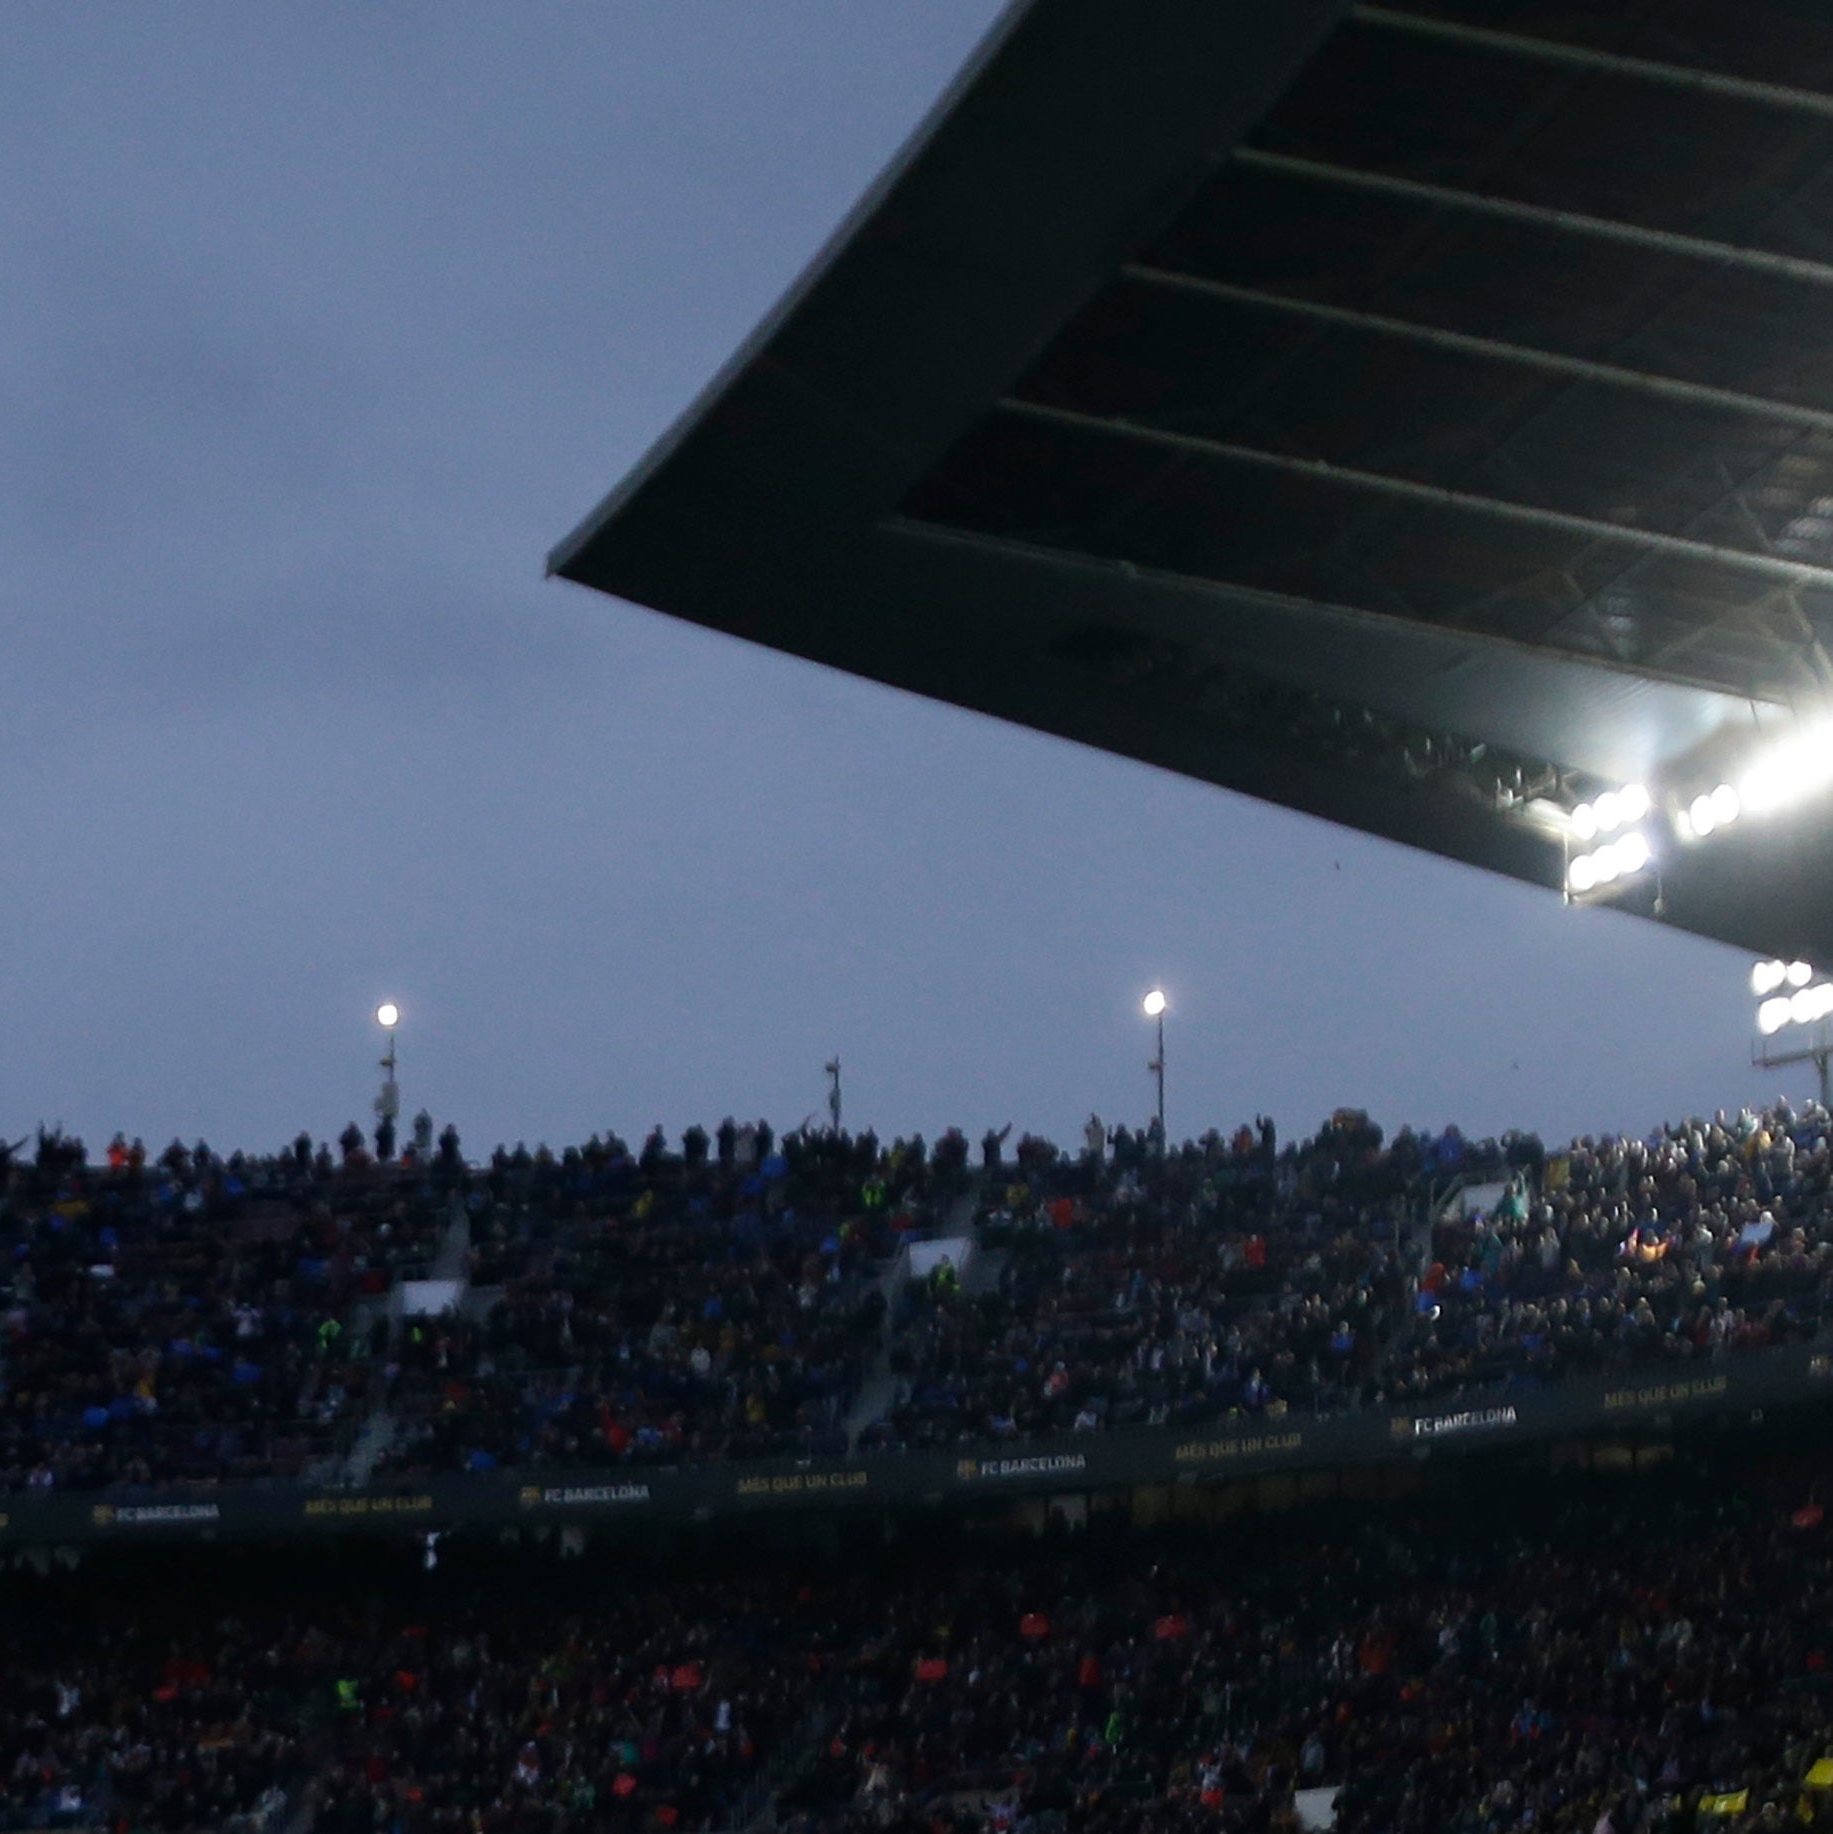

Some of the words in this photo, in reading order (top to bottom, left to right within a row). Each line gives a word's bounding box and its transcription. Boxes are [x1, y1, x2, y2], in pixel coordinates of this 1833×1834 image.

[1415, 1415, 1433, 1434] FC
[1434, 1406, 1517, 1431] BARCELONA
[981, 1458, 999, 1477] FC
[1000, 1454, 1086, 1476] BARCELONA
[544, 1485, 562, 1502] FC
[564, 1484, 650, 1502] BARCELONA
[136, 1504, 220, 1521] BARCELONA
